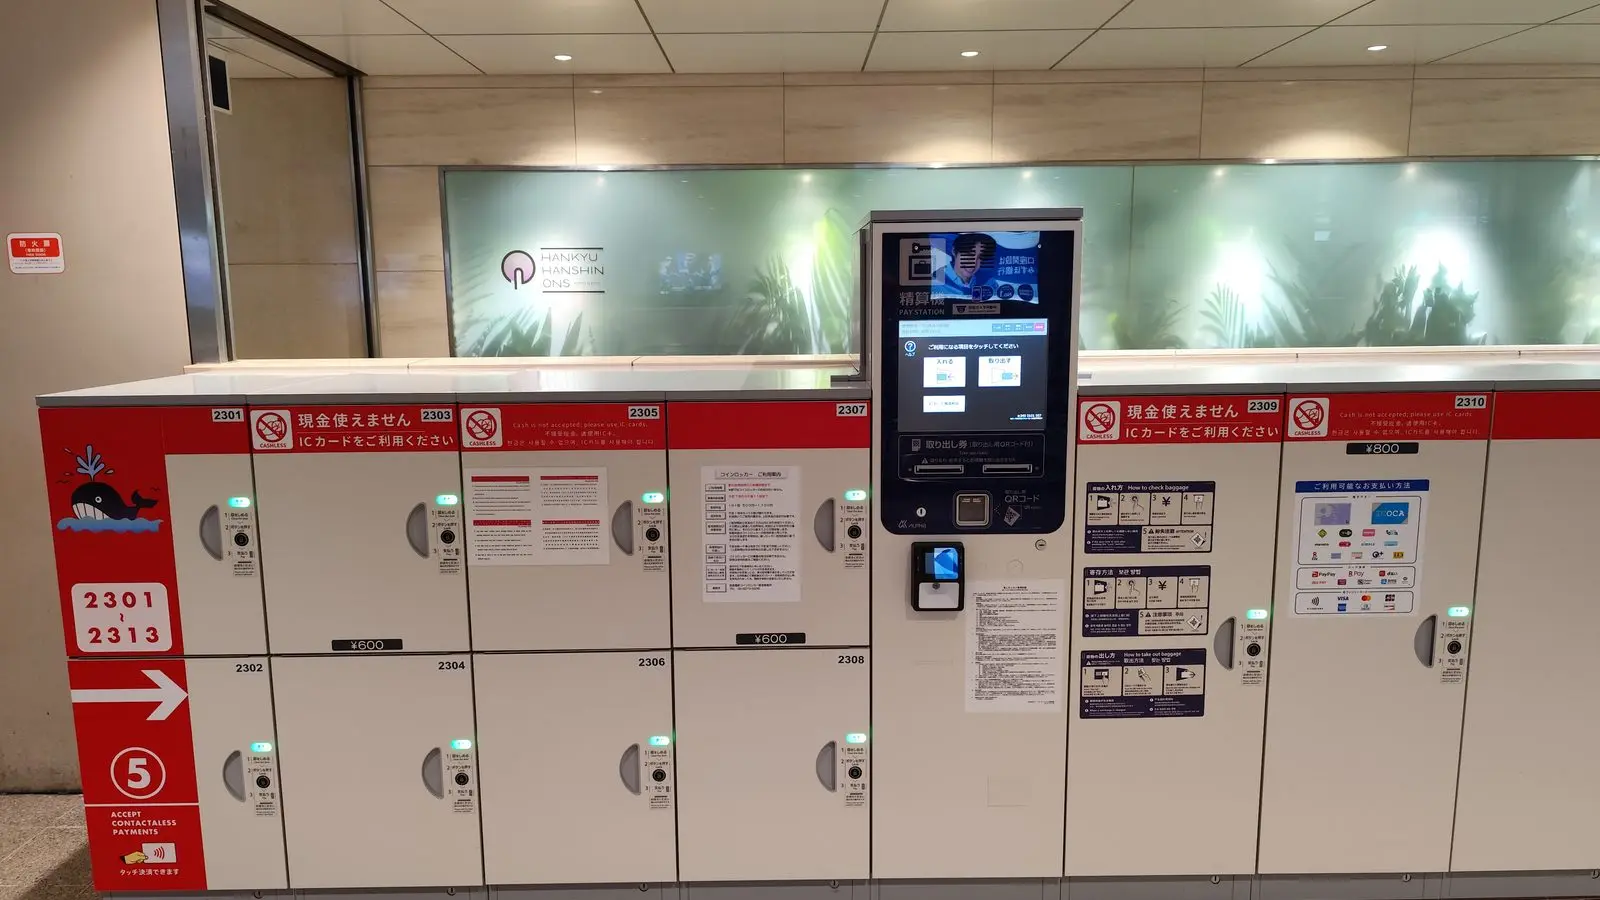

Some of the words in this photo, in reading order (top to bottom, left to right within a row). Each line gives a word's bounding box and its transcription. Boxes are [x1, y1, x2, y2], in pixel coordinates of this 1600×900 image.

[541, 253, 598, 261] HANKYU
[541, 266, 604, 275] HANSHIN
[542, 278, 570, 288] ONS
[1249, 401, 1277, 411] 2309
[1456, 397, 1485, 407] 2310
[629, 408, 658, 417] 2305
[838, 405, 866, 415] 2307
[1127, 404, 1239, 419] 現金使えません
[213, 411, 242, 420] 2301
[298, 413, 411, 428] 現金使えません
[423, 411, 451, 420] 2303
[1125, 426, 1279, 438] ICカードをご利用ください
[299, 435, 454, 447] ICカードをご利用ください
[925, 439, 968, 449] 取り出し券
[1365, 443, 1400, 454] ¥800
[1314, 482, 1411, 490] ご利用可能なお支払い方法
[1004, 494, 1041, 503] QRコード
[84, 591, 153, 608] 2301
[88, 627, 159, 643] 2313
[754, 634, 787, 644] ¥600
[350, 640, 384, 650] ¥600
[638, 658, 665, 667] 2306
[838, 655, 865, 664] 2308
[235, 664, 263, 672] 2302
[438, 661, 466, 670] 2304
[127, 757, 151, 789] 5
